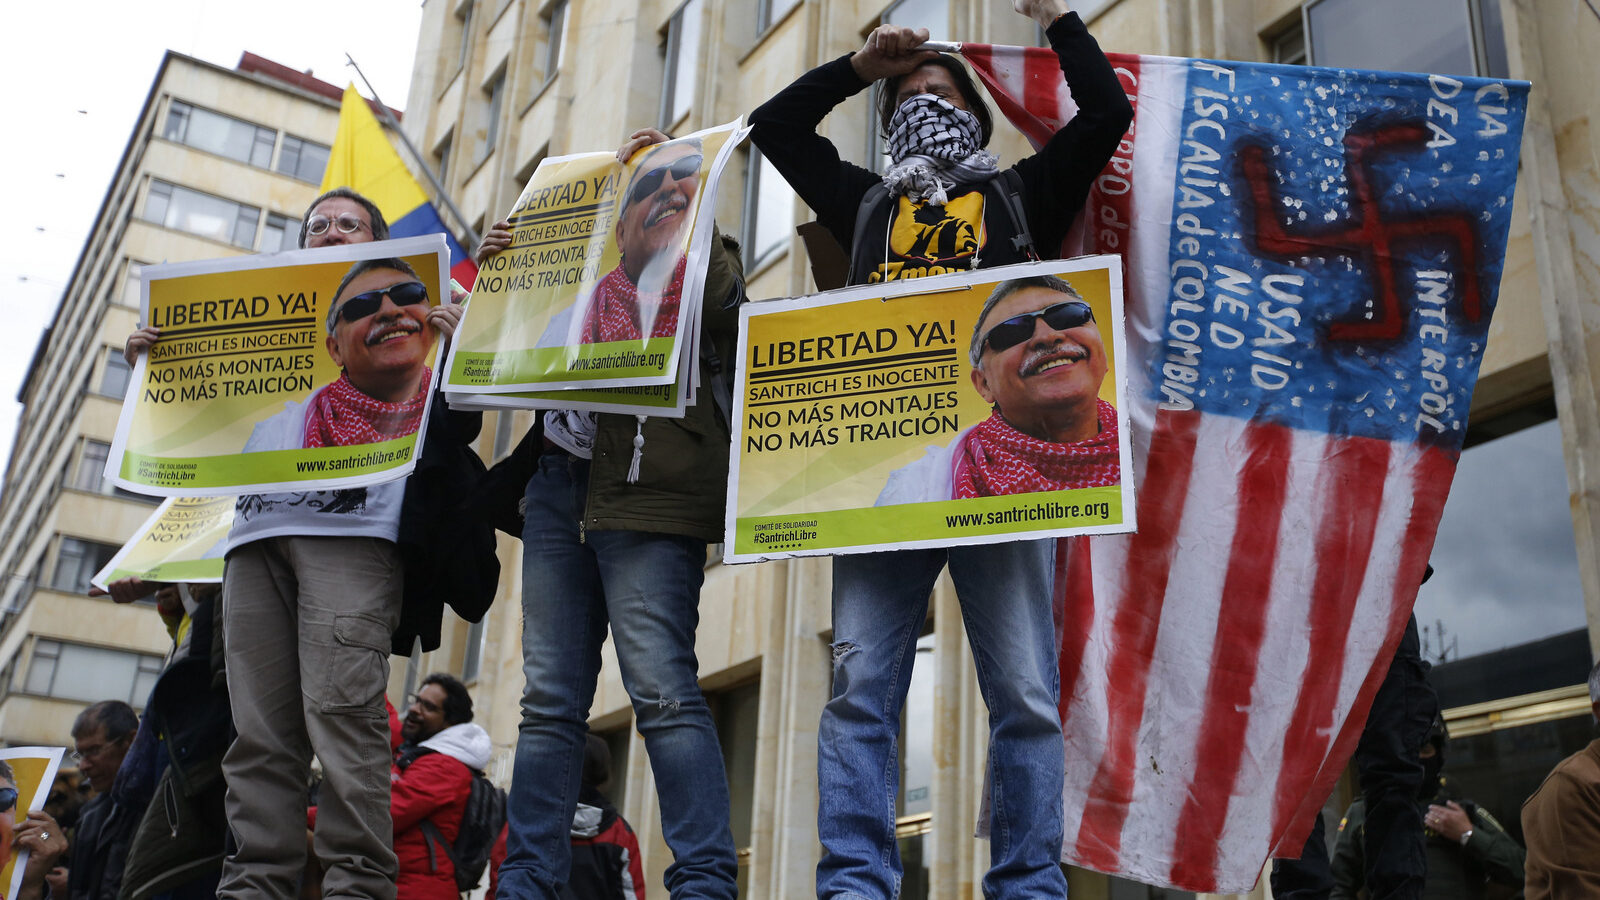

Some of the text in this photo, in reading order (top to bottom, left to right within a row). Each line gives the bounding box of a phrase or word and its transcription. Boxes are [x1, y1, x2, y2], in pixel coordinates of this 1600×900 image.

[1426, 74, 1463, 148] DEA
[1474, 83, 1510, 137] CIA
[515, 172, 622, 213] BERTAD YA!
[511, 215, 613, 244] TRICH ES INOCENTE
[1101, 204, 1129, 249] de
[482, 241, 606, 271] NO MÁS MONTAJES
[476, 277, 503, 293] NO
[504, 270, 535, 293] MÁS
[152, 291, 317, 328] LIBERTAD YA!
[1209, 264, 1254, 349] NED
[150, 331, 317, 360] SANTRICH ES INOCENTE
[752, 320, 955, 368] LIBERTAD YA!
[148, 354, 314, 384] NO MÁS MONTAJES
[569, 351, 665, 370] www.santrichlibre.org
[144, 371, 314, 404] NO MÁS TRAICIÓN
[749, 364, 959, 401] SANTRICH ES INOCENTE
[748, 391, 958, 429] NO MÁS MONTAJES
[747, 411, 959, 453] NO MÁS TRAICIÓN
[137, 467, 196, 480] #SantrichLibre
[296, 446, 410, 472] www.santrichlibre.org
[783, 520, 817, 529] SOLIDARIDAD
[945, 502, 1109, 528] www.santrichlibre.org
[754, 530, 817, 543] #SantrichLibre
